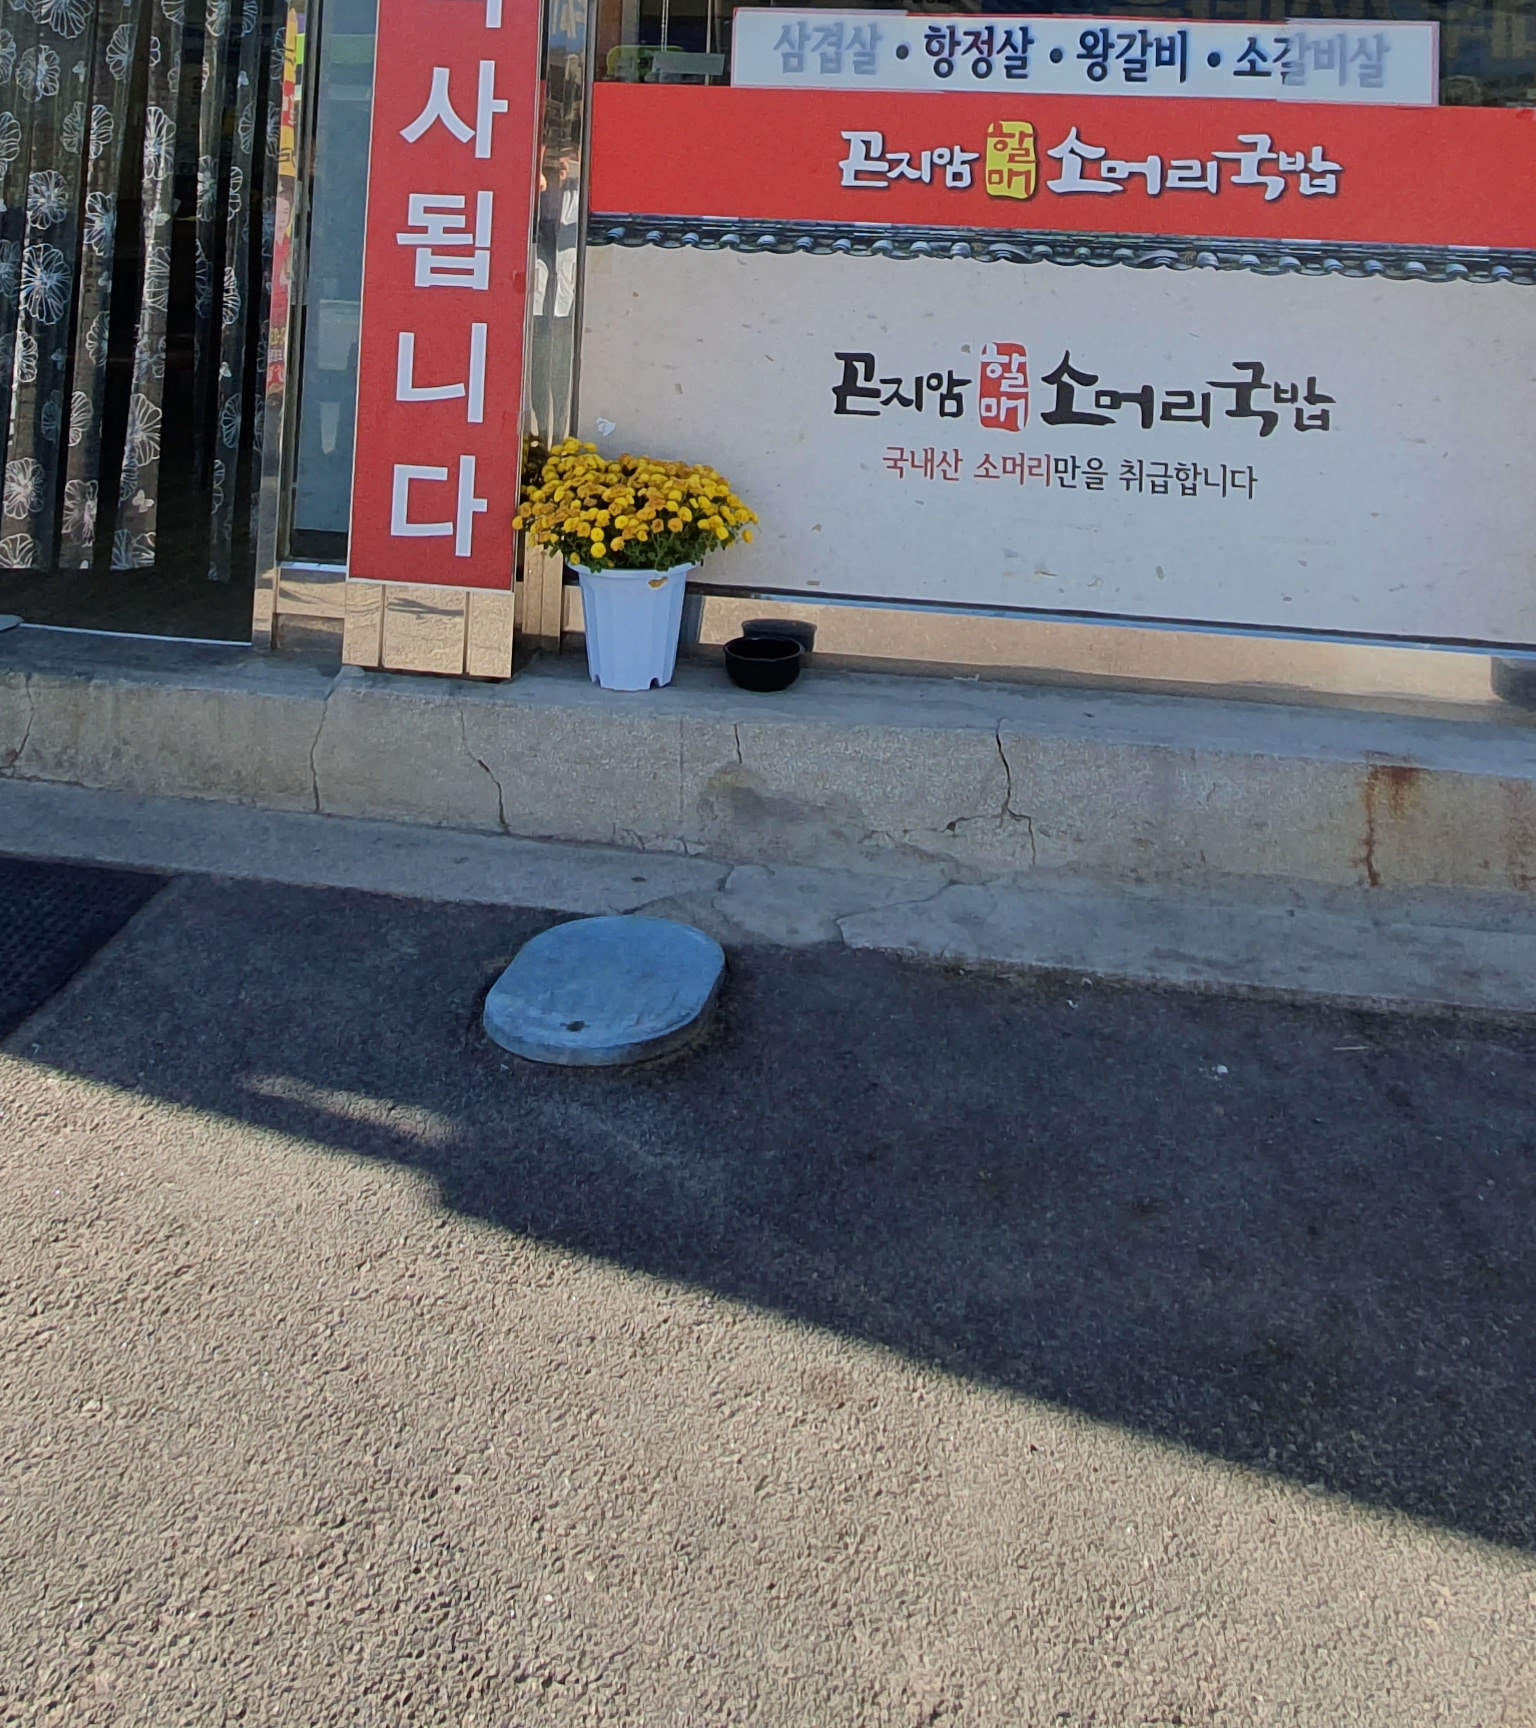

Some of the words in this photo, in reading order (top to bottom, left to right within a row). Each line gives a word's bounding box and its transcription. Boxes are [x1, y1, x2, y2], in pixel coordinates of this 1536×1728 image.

[773, 20, 882, 75] 삼겹살
[924, 24, 1034, 80] 항정살
[1076, 29, 1189, 85] 왕갈비
[1234, 31, 1389, 87] 소갈비살
[838, 130, 979, 189] 곤지암
[1047, 126, 1344, 202] 소머리국밥
[831, 351, 972, 418] 곤지암
[979, 342, 1030, 432] 할매
[1040, 350, 1337, 438] 소머리국밥
[882, 445, 964, 482] 국내산
[975, 450, 1110, 493] 소머리만을
[1119, 458, 1258, 501] 취급합니다
